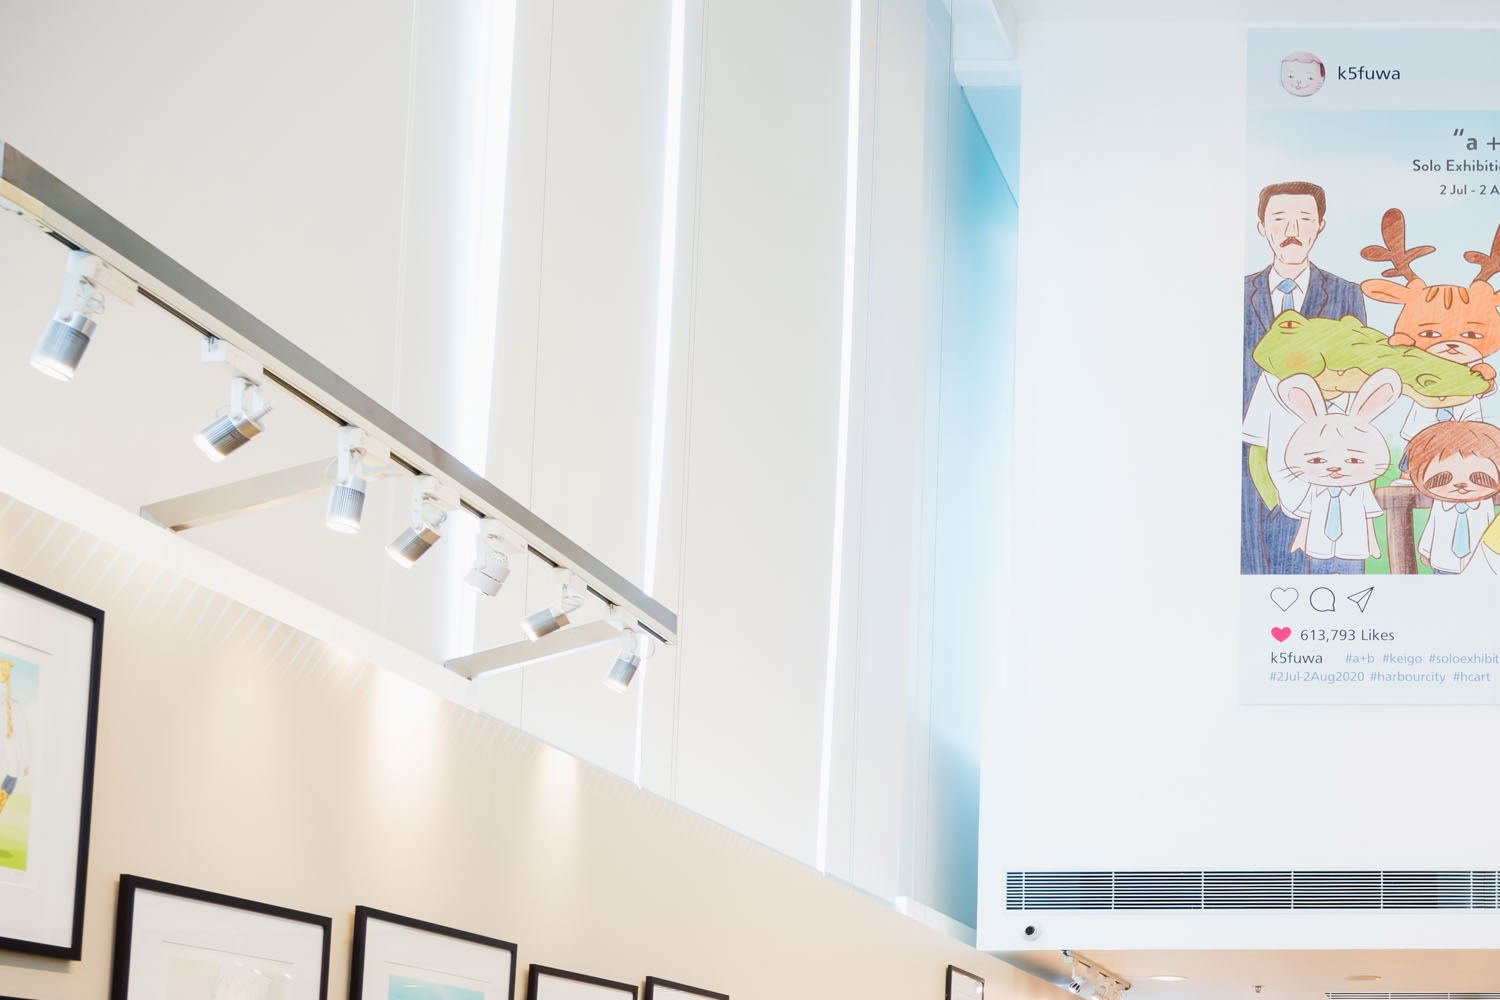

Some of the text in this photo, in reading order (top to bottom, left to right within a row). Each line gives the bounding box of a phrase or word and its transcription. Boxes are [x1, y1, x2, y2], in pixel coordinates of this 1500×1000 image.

[1338, 65, 1400, 80] k5fuwa
[1412, 159, 1441, 172] Solo
[1439, 184, 1446, 195] 2
[1449, 183, 1466, 195] Jul
[1479, 184, 1486, 195] 2
[1300, 628, 1394, 642] 613,793 Likes
[1271, 651, 1322, 663] k5fuwa
[1345, 652, 1374, 663] #a+b
[1382, 652, 1422, 665] #keigo
[1269, 671, 1490, 684] #2Jul-2Aug2020 #harbourcity #hcart
